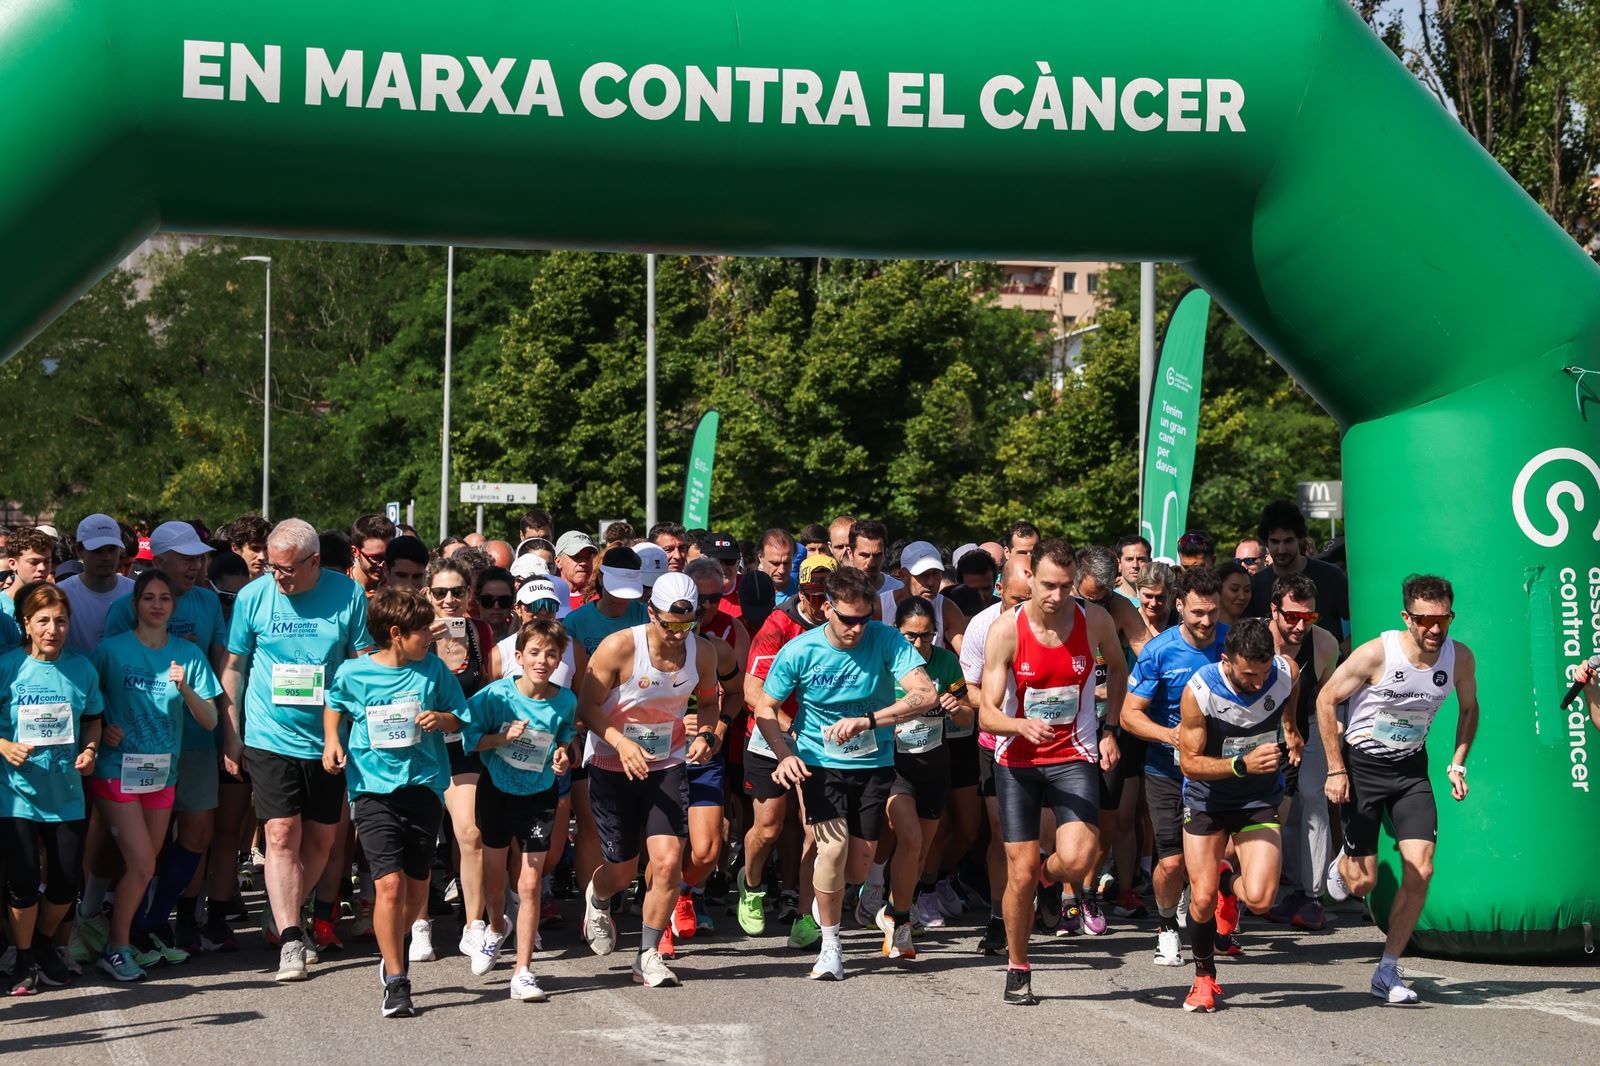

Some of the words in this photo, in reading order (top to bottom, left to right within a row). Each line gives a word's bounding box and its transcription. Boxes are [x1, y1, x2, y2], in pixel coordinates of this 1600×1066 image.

[182, 39, 281, 103] EN
[305, 47, 564, 117] MARXA
[579, 61, 871, 126] CONTRA
[887, 72, 965, 129] EL
[979, 61, 1246, 132] CÀNCER
[1162, 400, 1183, 420] Tenim
[1160, 417, 1169, 428] un
[1169, 421, 1187, 436] gran
[1157, 446, 1170, 458] per
[529, 584, 554, 593] Wilson
[1559, 567, 1584, 657] contra
[272, 622, 293, 634] KM
[293, 621, 318, 629] contra
[123, 675, 146, 688] KM
[812, 674, 834, 686] KM
[39, 694, 67, 702] contra
[285, 688, 300, 697] 905
[1043, 711, 1061, 720] 209
[41, 729, 53, 738] 50
[388, 730, 407, 740] 558
[1390, 733, 1408, 743] 456
[917, 738, 928, 747] 80
[1567, 695, 1591, 793] càncer
[843, 745, 860, 754] 296
[511, 751, 529, 763] 557
